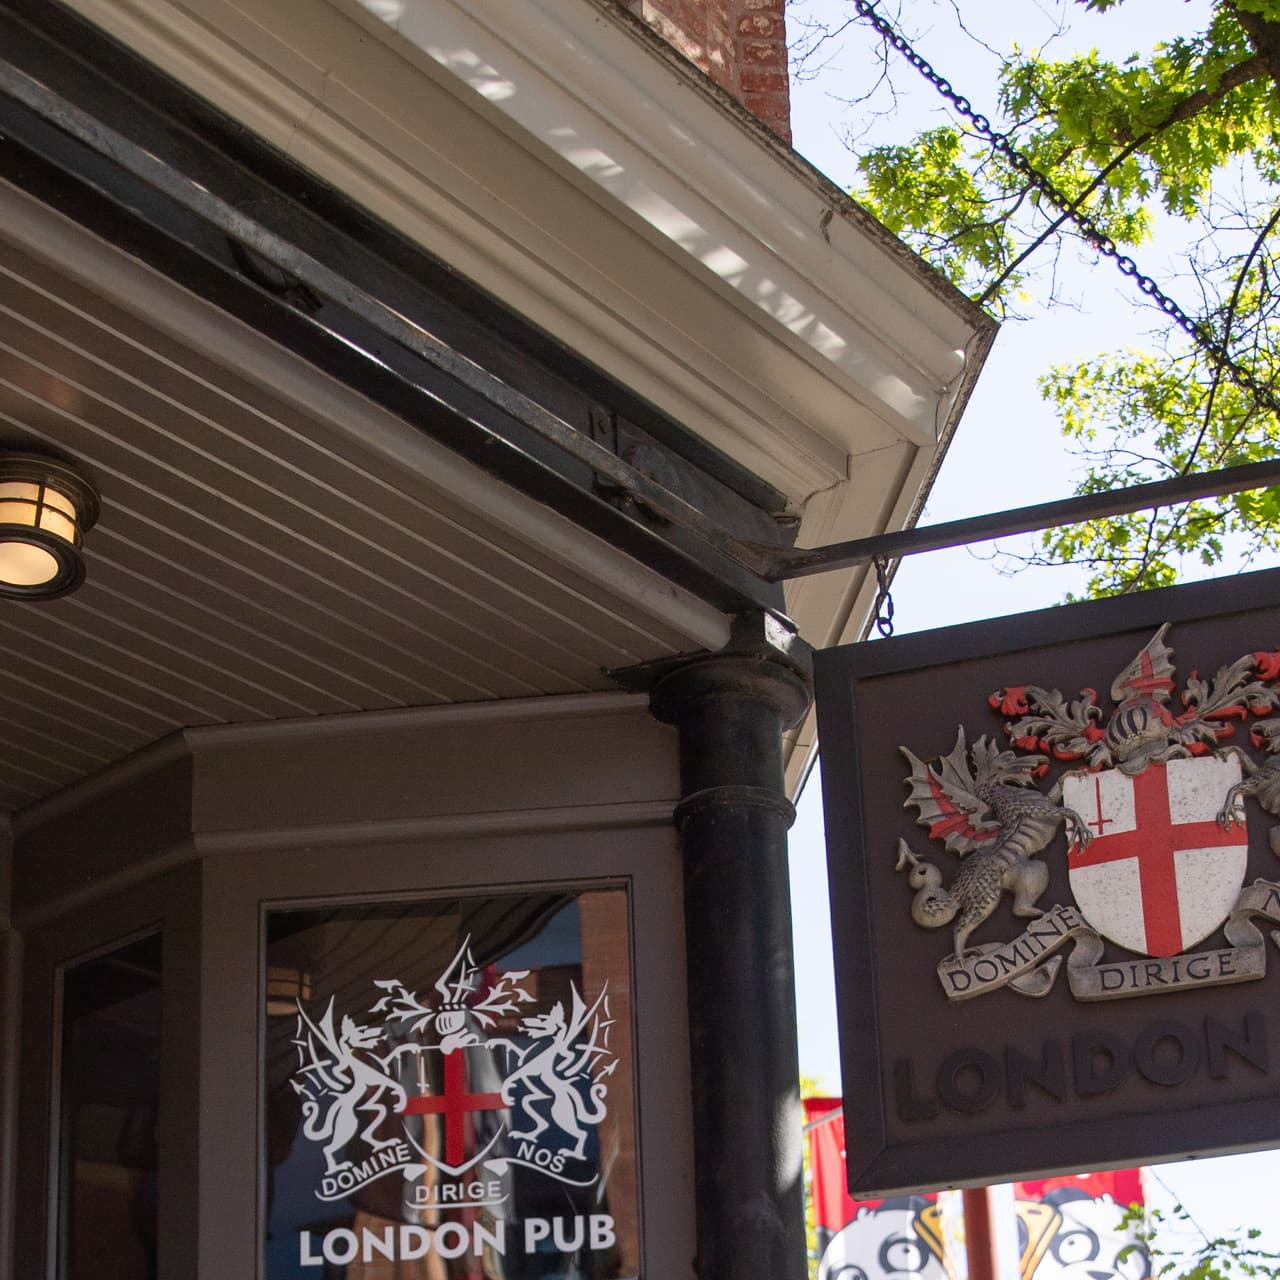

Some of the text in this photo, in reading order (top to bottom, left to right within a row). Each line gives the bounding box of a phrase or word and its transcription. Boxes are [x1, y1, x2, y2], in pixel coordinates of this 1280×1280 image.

[948, 904, 1083, 992] DOMINE
[1100, 949, 1237, 992] DIRIGE
[894, 1010, 1270, 1123] LONDON
[321, 1143, 412, 1197] DOMINE
[517, 1143, 567, 1174] NOS
[415, 1180, 502, 1203] DIRIGE
[299, 1214, 617, 1267] LONDON PUB
